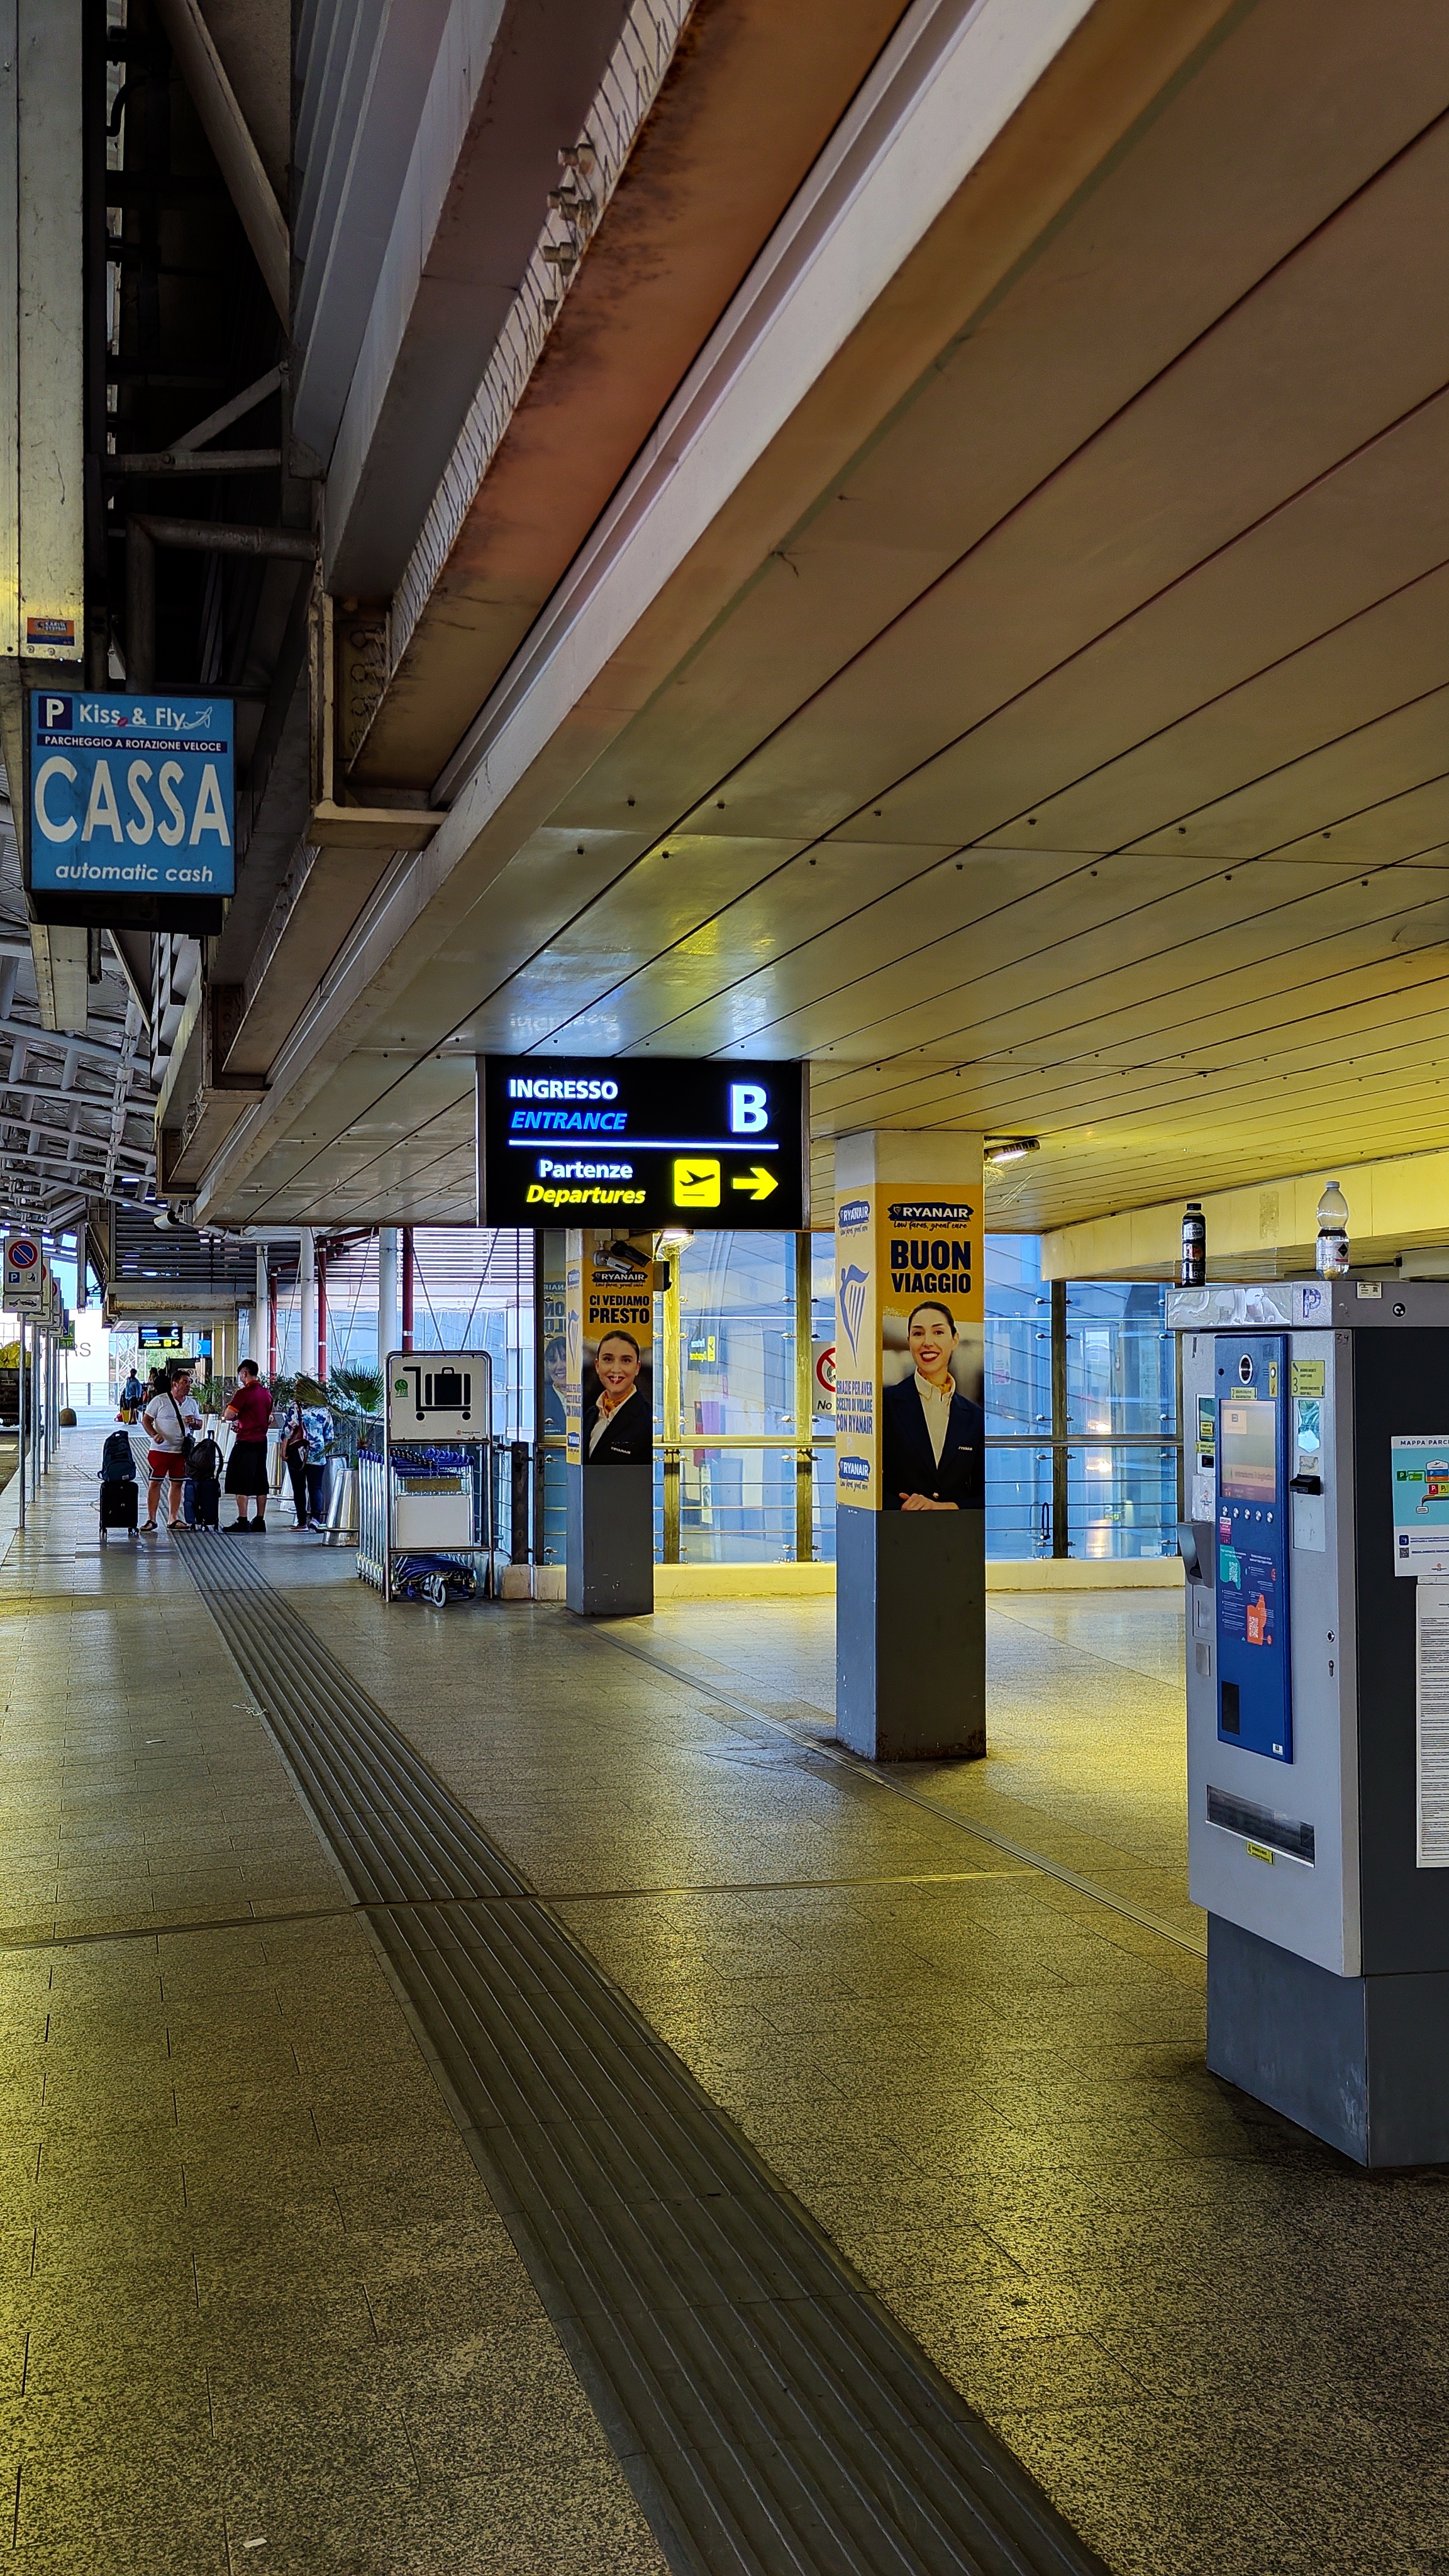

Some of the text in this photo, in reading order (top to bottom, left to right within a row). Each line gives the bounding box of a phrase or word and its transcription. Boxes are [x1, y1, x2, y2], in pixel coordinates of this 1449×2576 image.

[46, 698, 64, 727] P
[80, 704, 186, 731] Kiss & Fly
[45, 736, 221, 752] PARCHEGGIO A ROTAZIONE VELOCE
[35, 755, 231, 846] CASSA
[55, 862, 213, 882] automatic cash
[509, 1079, 619, 1100] INGRESSO
[731, 1084, 769, 1133] B
[511, 1111, 628, 1130] ENTRANCE
[540, 1158, 633, 1179] Partenze
[526, 1185, 646, 1208] Departures
[843, 1206, 869, 1222] RYANAIR
[902, 1207, 969, 1218] RYANAIR
[894, 1219, 908, 1229] Low
[909, 1219, 929, 1230] fares,
[929, 1221, 950, 1231] great
[891, 1240, 971, 1270] BUON
[11, 1274, 18, 1282] P
[891, 1273, 971, 1294] VIAGGIO
[589, 1294, 650, 1306] CI VEDIAMO
[1302, 1288, 1321, 1318] P
[589, 1307, 650, 1324] PRESTO
[171, 1329, 179, 1337] C
[852, 1381, 860, 1396] PER
[861, 1381, 872, 1396] AVER
[1292, 1377, 1298, 1393] 3
[818, 1400, 832, 1410] No
[836, 1397, 851, 1411] SCELTO
[857, 1398, 872, 1413] VOLARE
[836, 1414, 872, 1435] CON RYANAIR
[843, 1460, 869, 1477] RYANAIR
